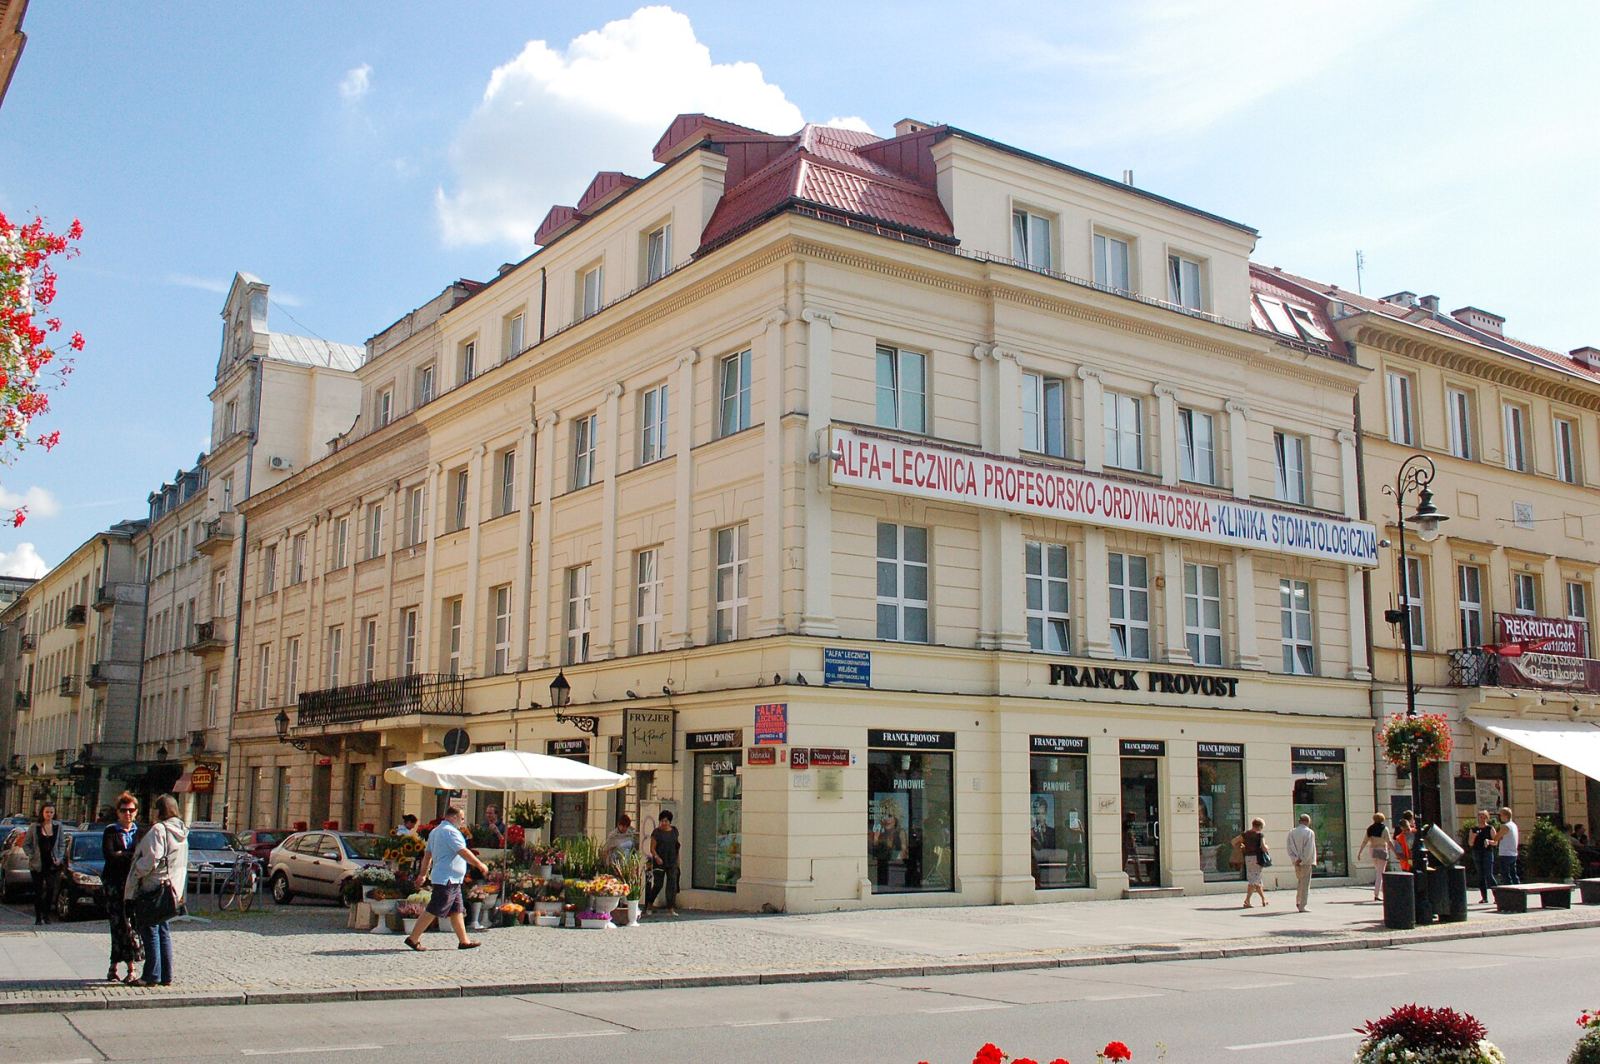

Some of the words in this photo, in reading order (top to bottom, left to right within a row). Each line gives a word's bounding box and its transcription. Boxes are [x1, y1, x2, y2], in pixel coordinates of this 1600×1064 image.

[834, 438, 977, 496] ALFA-LECZNICA
[1272, 513, 1378, 559] STOMATOLOGICZNA
[1505, 619, 1576, 640] REKRUTACJA
[1543, 641, 1576, 652] 2011/2012
[844, 651, 869, 659] LECZNICA
[1049, 664, 1140, 691] FRANCK
[1147, 671, 1239, 698] PROVOST
[629, 713, 670, 722] FRYZJER
[696, 734, 713, 742] FRANCK
[713, 733, 735, 741] PROVOST
[883, 732, 909, 741] FRANCK
[910, 734, 940, 743] PROVOST
[1034, 738, 1057, 746] FRANCK
[1058, 739, 1083, 747] PROVOST
[1198, 744, 1218, 752] FRANCK
[1219, 745, 1240, 753] PROVOST
[814, 752, 831, 762] Nowy
[832, 752, 847, 761] Świat
[192, 774, 211, 784] BAR
[893, 779, 926, 789] PANOWIE
[1043, 781, 1071, 791] PANOWIE
[1211, 784, 1226, 793] PANIE
